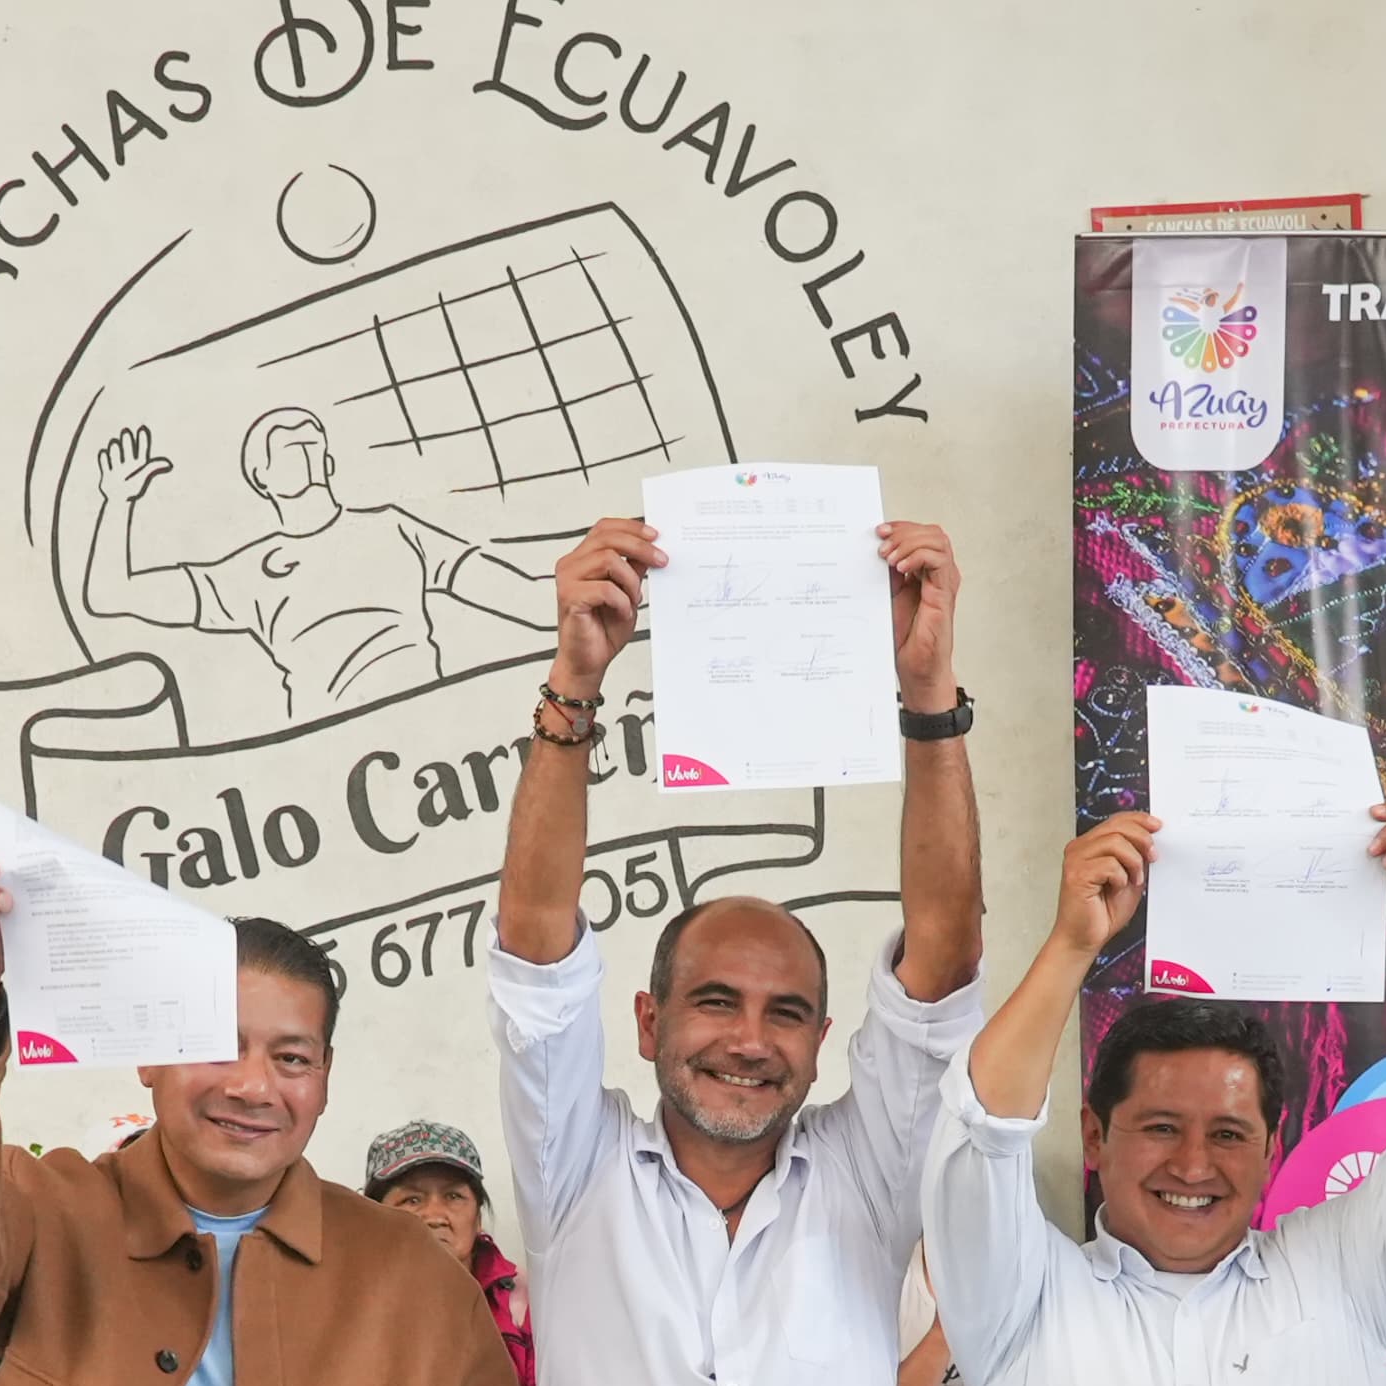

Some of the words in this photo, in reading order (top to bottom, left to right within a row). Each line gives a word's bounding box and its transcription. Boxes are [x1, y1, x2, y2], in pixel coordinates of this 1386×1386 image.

[253, 0, 434, 106] DE
[474, 0, 929, 424] ECUAVOLEY
[1160, 421, 1245, 430] PREFECTURA
[102, 788, 321, 890] Galo
[371, 900, 486, 988] 677
